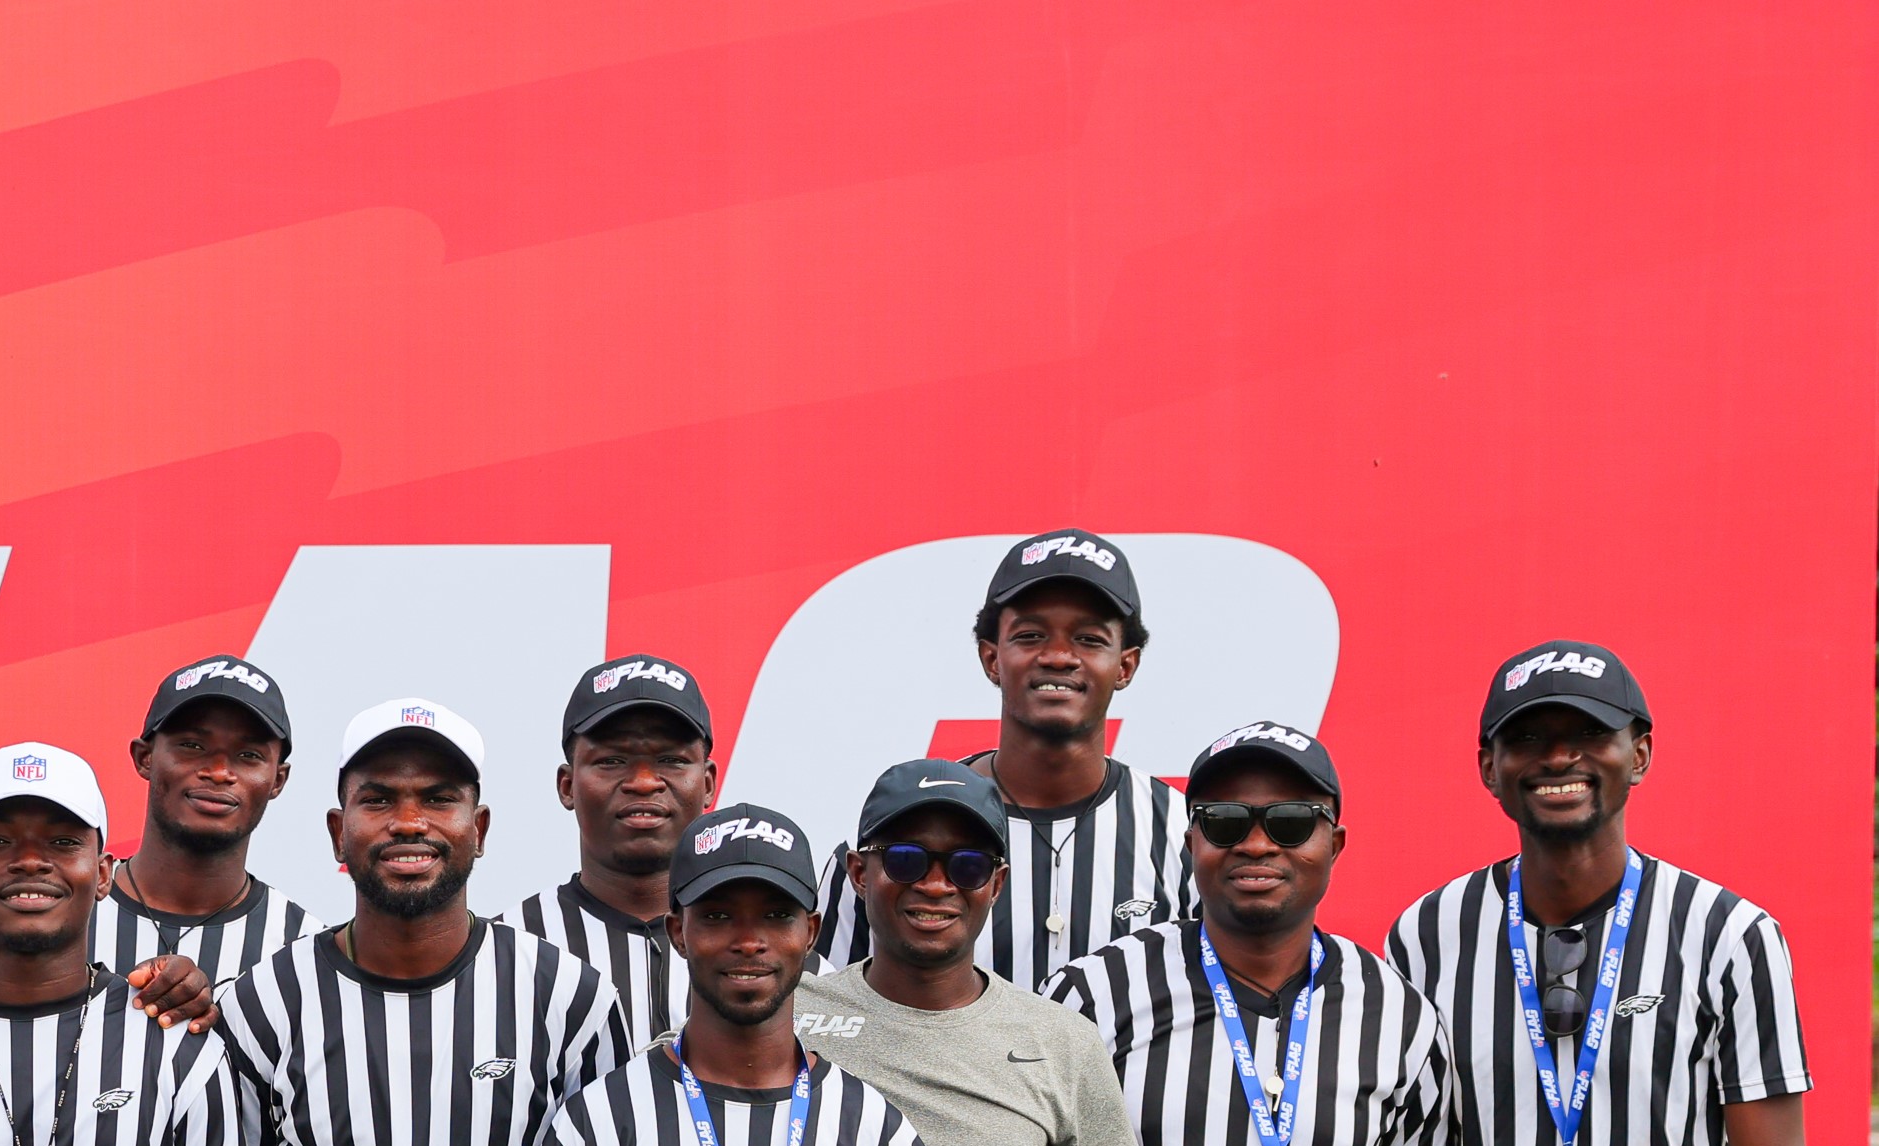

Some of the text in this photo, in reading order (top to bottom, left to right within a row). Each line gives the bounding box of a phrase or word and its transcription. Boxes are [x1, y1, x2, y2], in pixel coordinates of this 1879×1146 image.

[1037, 536, 1116, 571] FLAG
[191, 661, 269, 693] FLAG
[610, 661, 687, 691] FLAG
[1520, 651, 1606, 679] FLAG
[405, 713, 431, 726] NFL
[1229, 723, 1311, 752] FLAG
[16, 766, 43, 778] NFL
[712, 818, 794, 851] FLAG
[1509, 891, 1521, 920] FLAG
[1615, 892, 1634, 928] FLAG
[1512, 948, 1532, 980] FLAG
[1600, 953, 1619, 989] FLAG
[1214, 987, 1237, 1018] FLAG
[795, 1013, 865, 1037] FLAG
[1525, 1009, 1545, 1041] FLAG
[1586, 1013, 1604, 1050] FLAG
[1233, 1045, 1256, 1077] FLAG
[1287, 1041, 1302, 1075] FLAG
[1540, 1069, 1560, 1101] FLAG
[1571, 1075, 1589, 1111] FLAG
[1252, 1105, 1275, 1137] FLAG
[1279, 1101, 1293, 1136] FLAG
